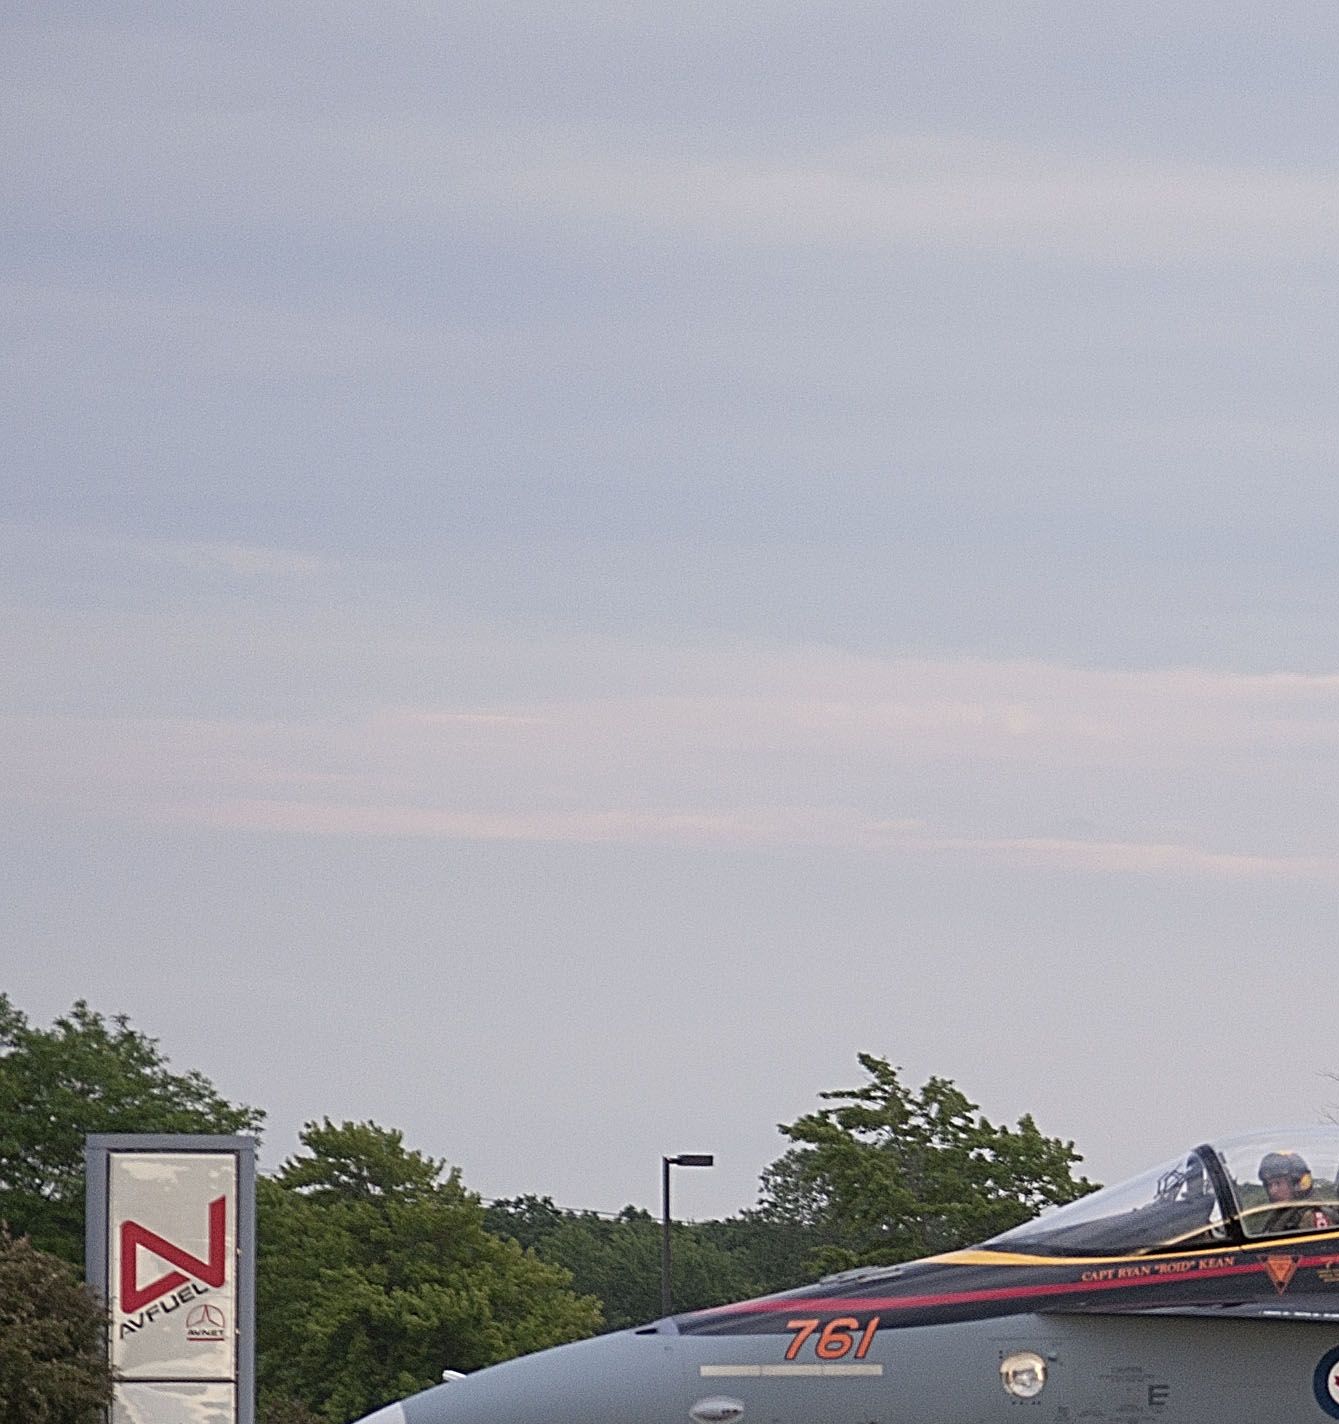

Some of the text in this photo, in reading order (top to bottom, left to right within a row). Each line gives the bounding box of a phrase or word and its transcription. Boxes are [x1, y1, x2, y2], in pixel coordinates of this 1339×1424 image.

[1081, 1269, 1114, 1282] CAPT
[1118, 1265, 1151, 1279] RYAN
[1198, 1256, 1235, 1270] KEAN
[119, 1283, 209, 1340] AVFUEL
[784, 1315, 880, 1360] 761
